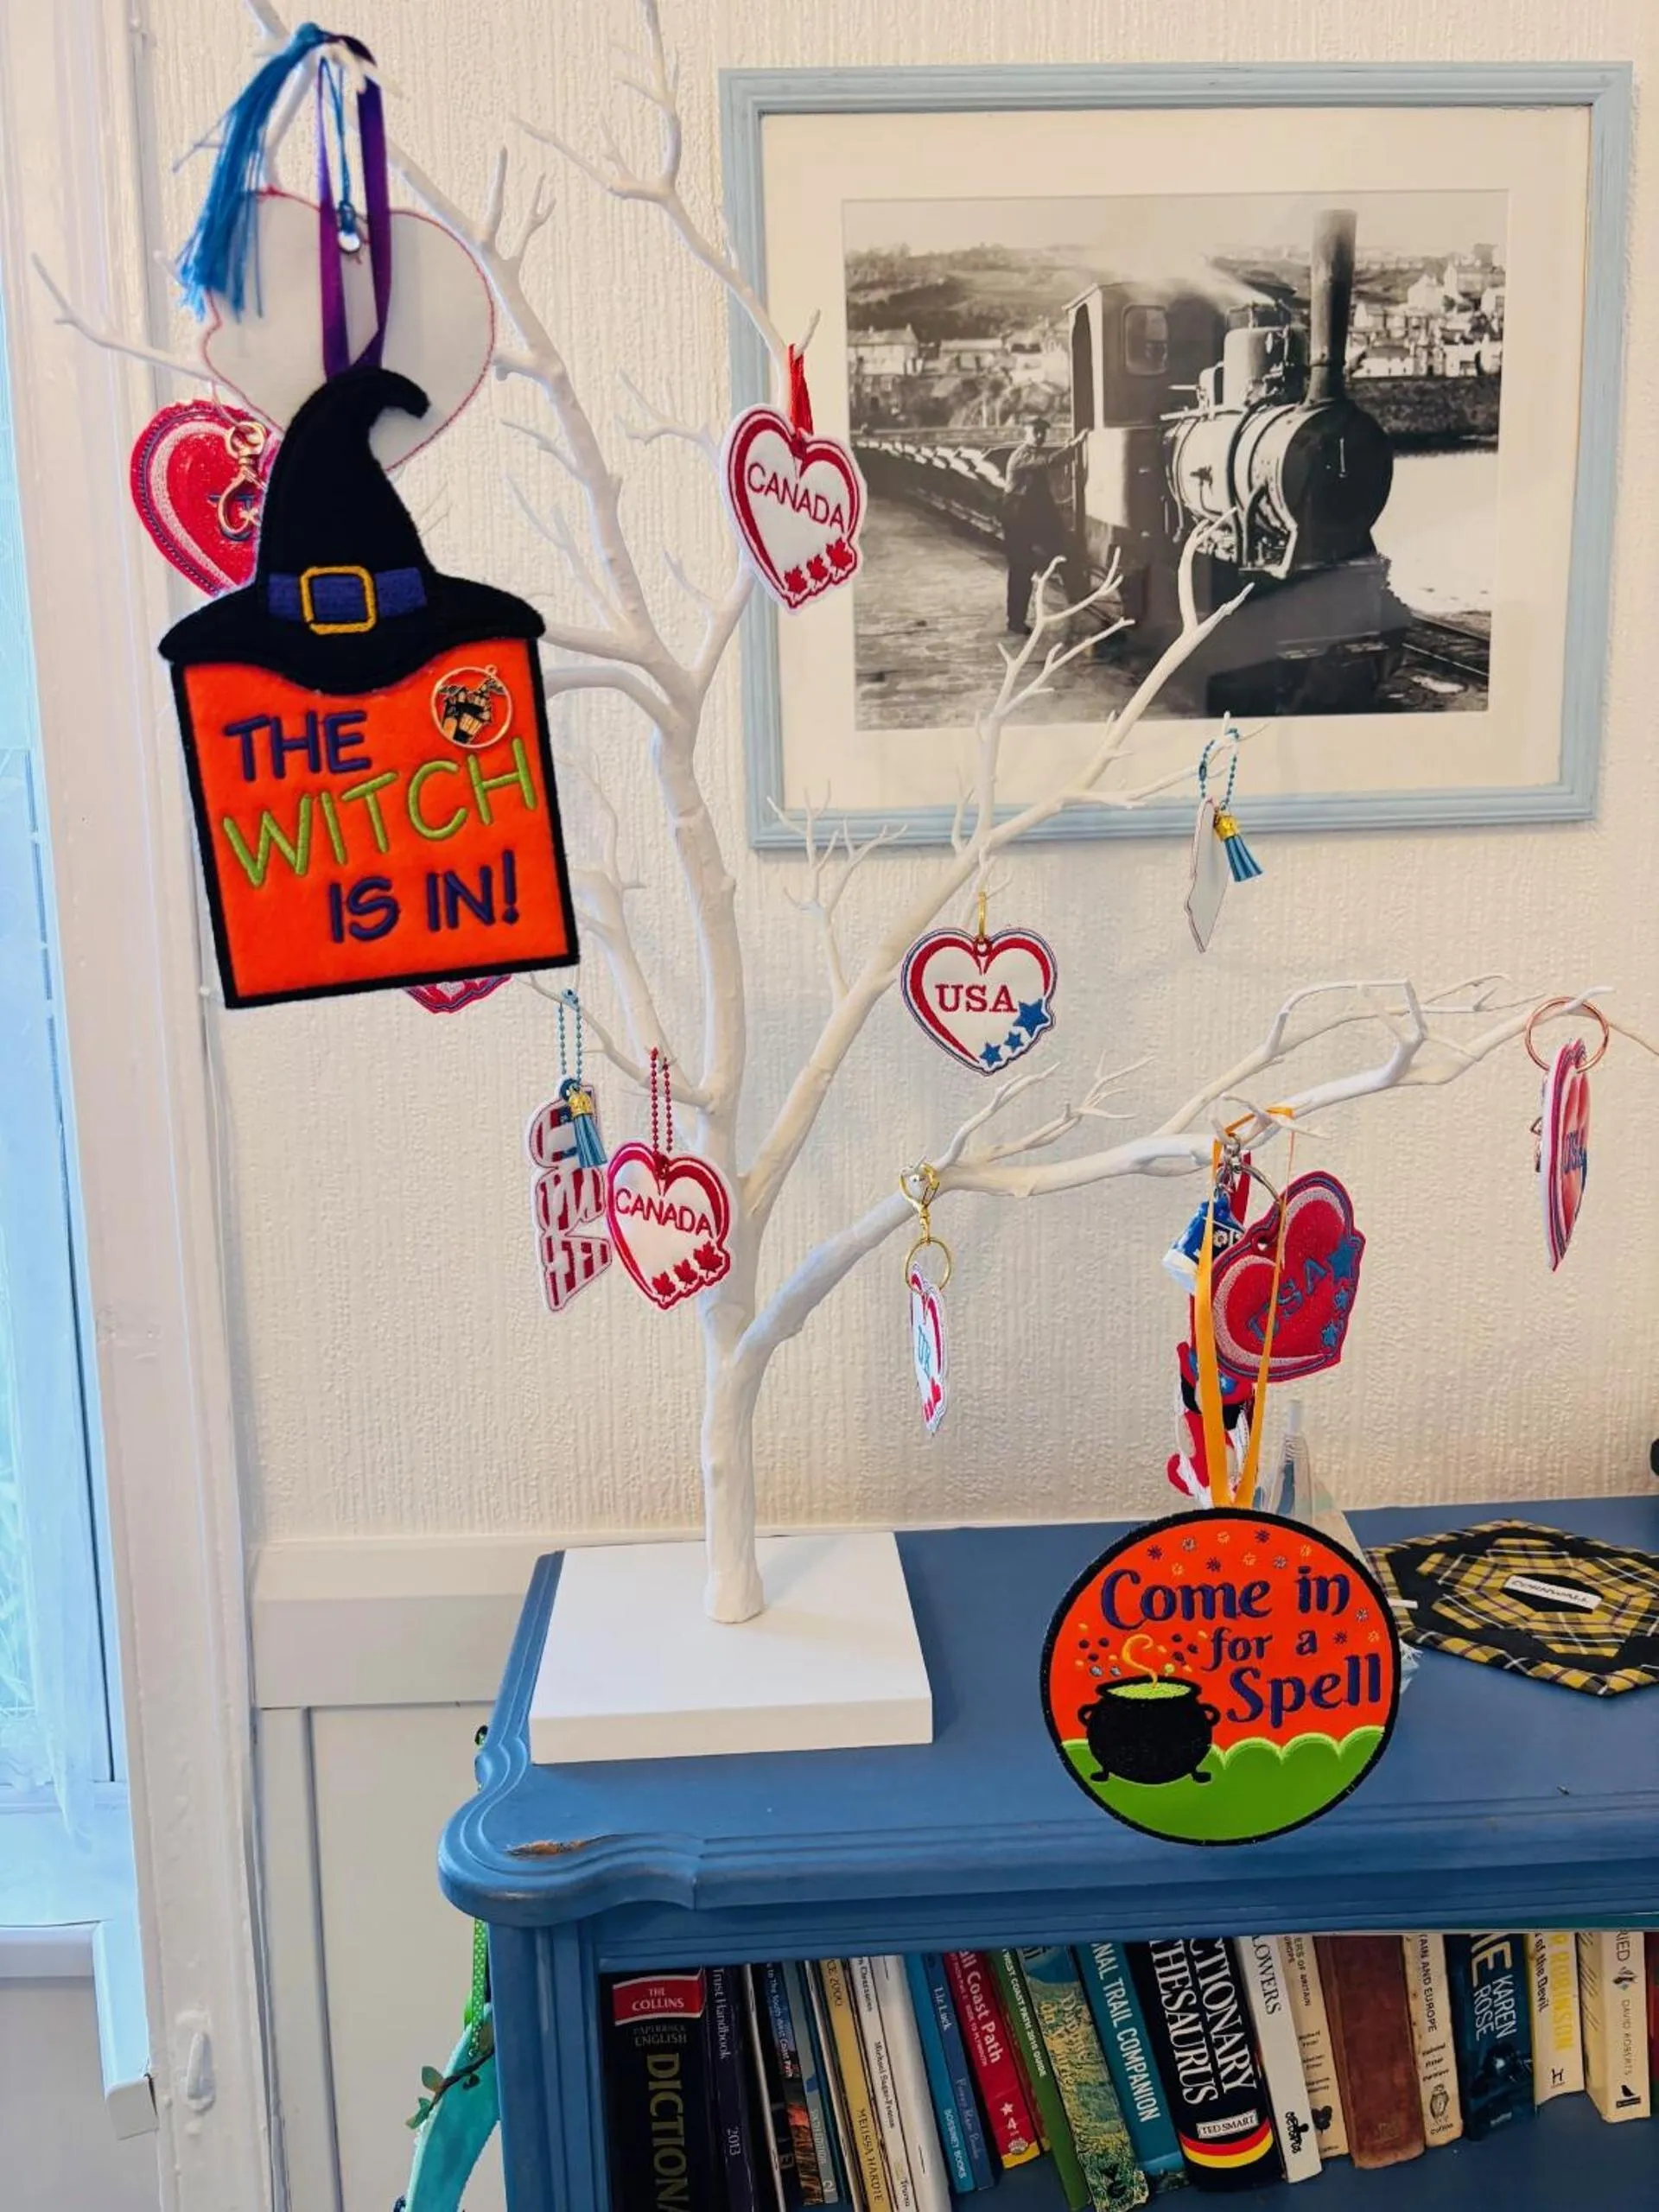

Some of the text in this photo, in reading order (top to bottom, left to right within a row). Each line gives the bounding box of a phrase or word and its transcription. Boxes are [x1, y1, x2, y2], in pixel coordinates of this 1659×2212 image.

[747, 462, 844, 533] CANADA
[222, 710, 372, 783] THE
[224, 737, 536, 887] WITCH
[328, 850, 520, 944] IS IN!
[935, 984, 1018, 1013] USA
[615, 1188, 714, 1237] CANADA
[1100, 1566, 1351, 1630] Come in
[1201, 1627, 1318, 1671] for a
[1225, 1653, 1382, 1728] Spell
[1421, 1961, 1433, 1986] AND
[1535, 1955, 1548, 1976] the
[632, 1998, 685, 2012] COLLINS
[649, 1988, 666, 1998] THE
[968, 1971, 990, 2021] Coast
[982, 2022, 1003, 2063] Path
[1003, 1953, 1015, 1977] WEST
[1011, 1978, 1025, 2005] COAST
[1020, 2006, 1033, 2030] PATH
[1033, 2050, 1046, 2077] GUIDE
[1103, 1978, 1134, 2027] TRAIL
[1424, 1988, 1437, 2033] EUROPE
[1472, 1986, 1494, 2041] ROSE
[1492, 1974, 1517, 2038] KAREN
[1539, 1976, 1551, 2012] Devil
[1551, 1952, 1575, 2050] ROBINSON
[1621, 1999, 1631, 2030] DAVID
[634, 2032, 688, 2047] ENGLISH
[939, 2005, 951, 2031] Luck
[714, 1998, 731, 2060] Handbook
[728, 2127, 741, 2157] 2013
[874, 2041, 887, 2074] Michael
[1117, 2027, 1161, 2122] COMPANION
[855, 2109, 875, 2158] MELISSA
[1219, 2116, 1255, 2133] SMART
